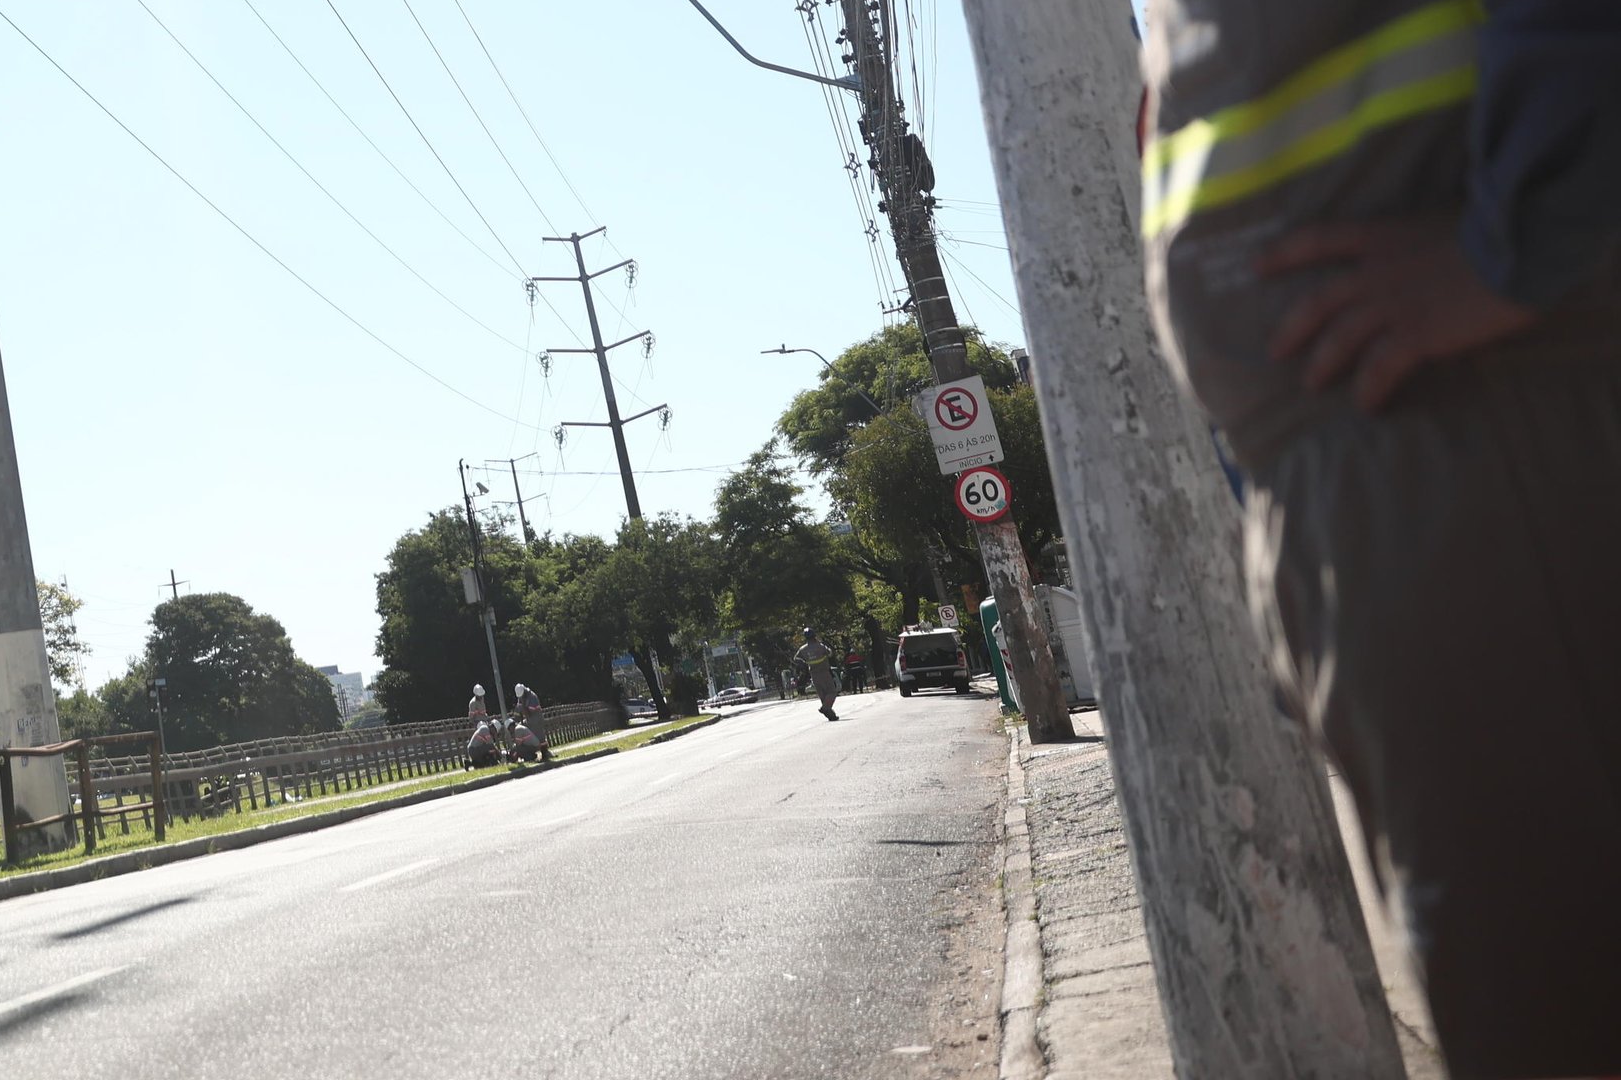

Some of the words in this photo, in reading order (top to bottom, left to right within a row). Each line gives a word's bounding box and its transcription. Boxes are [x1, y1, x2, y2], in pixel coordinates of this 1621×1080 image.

[938, 442, 957, 455] DAS
[958, 440, 964, 450] 6
[980, 433, 996, 444] 20h
[959, 456, 983, 469] INÍCIO
[965, 479, 999, 505] 60
[976, 505, 996, 515] km/h
